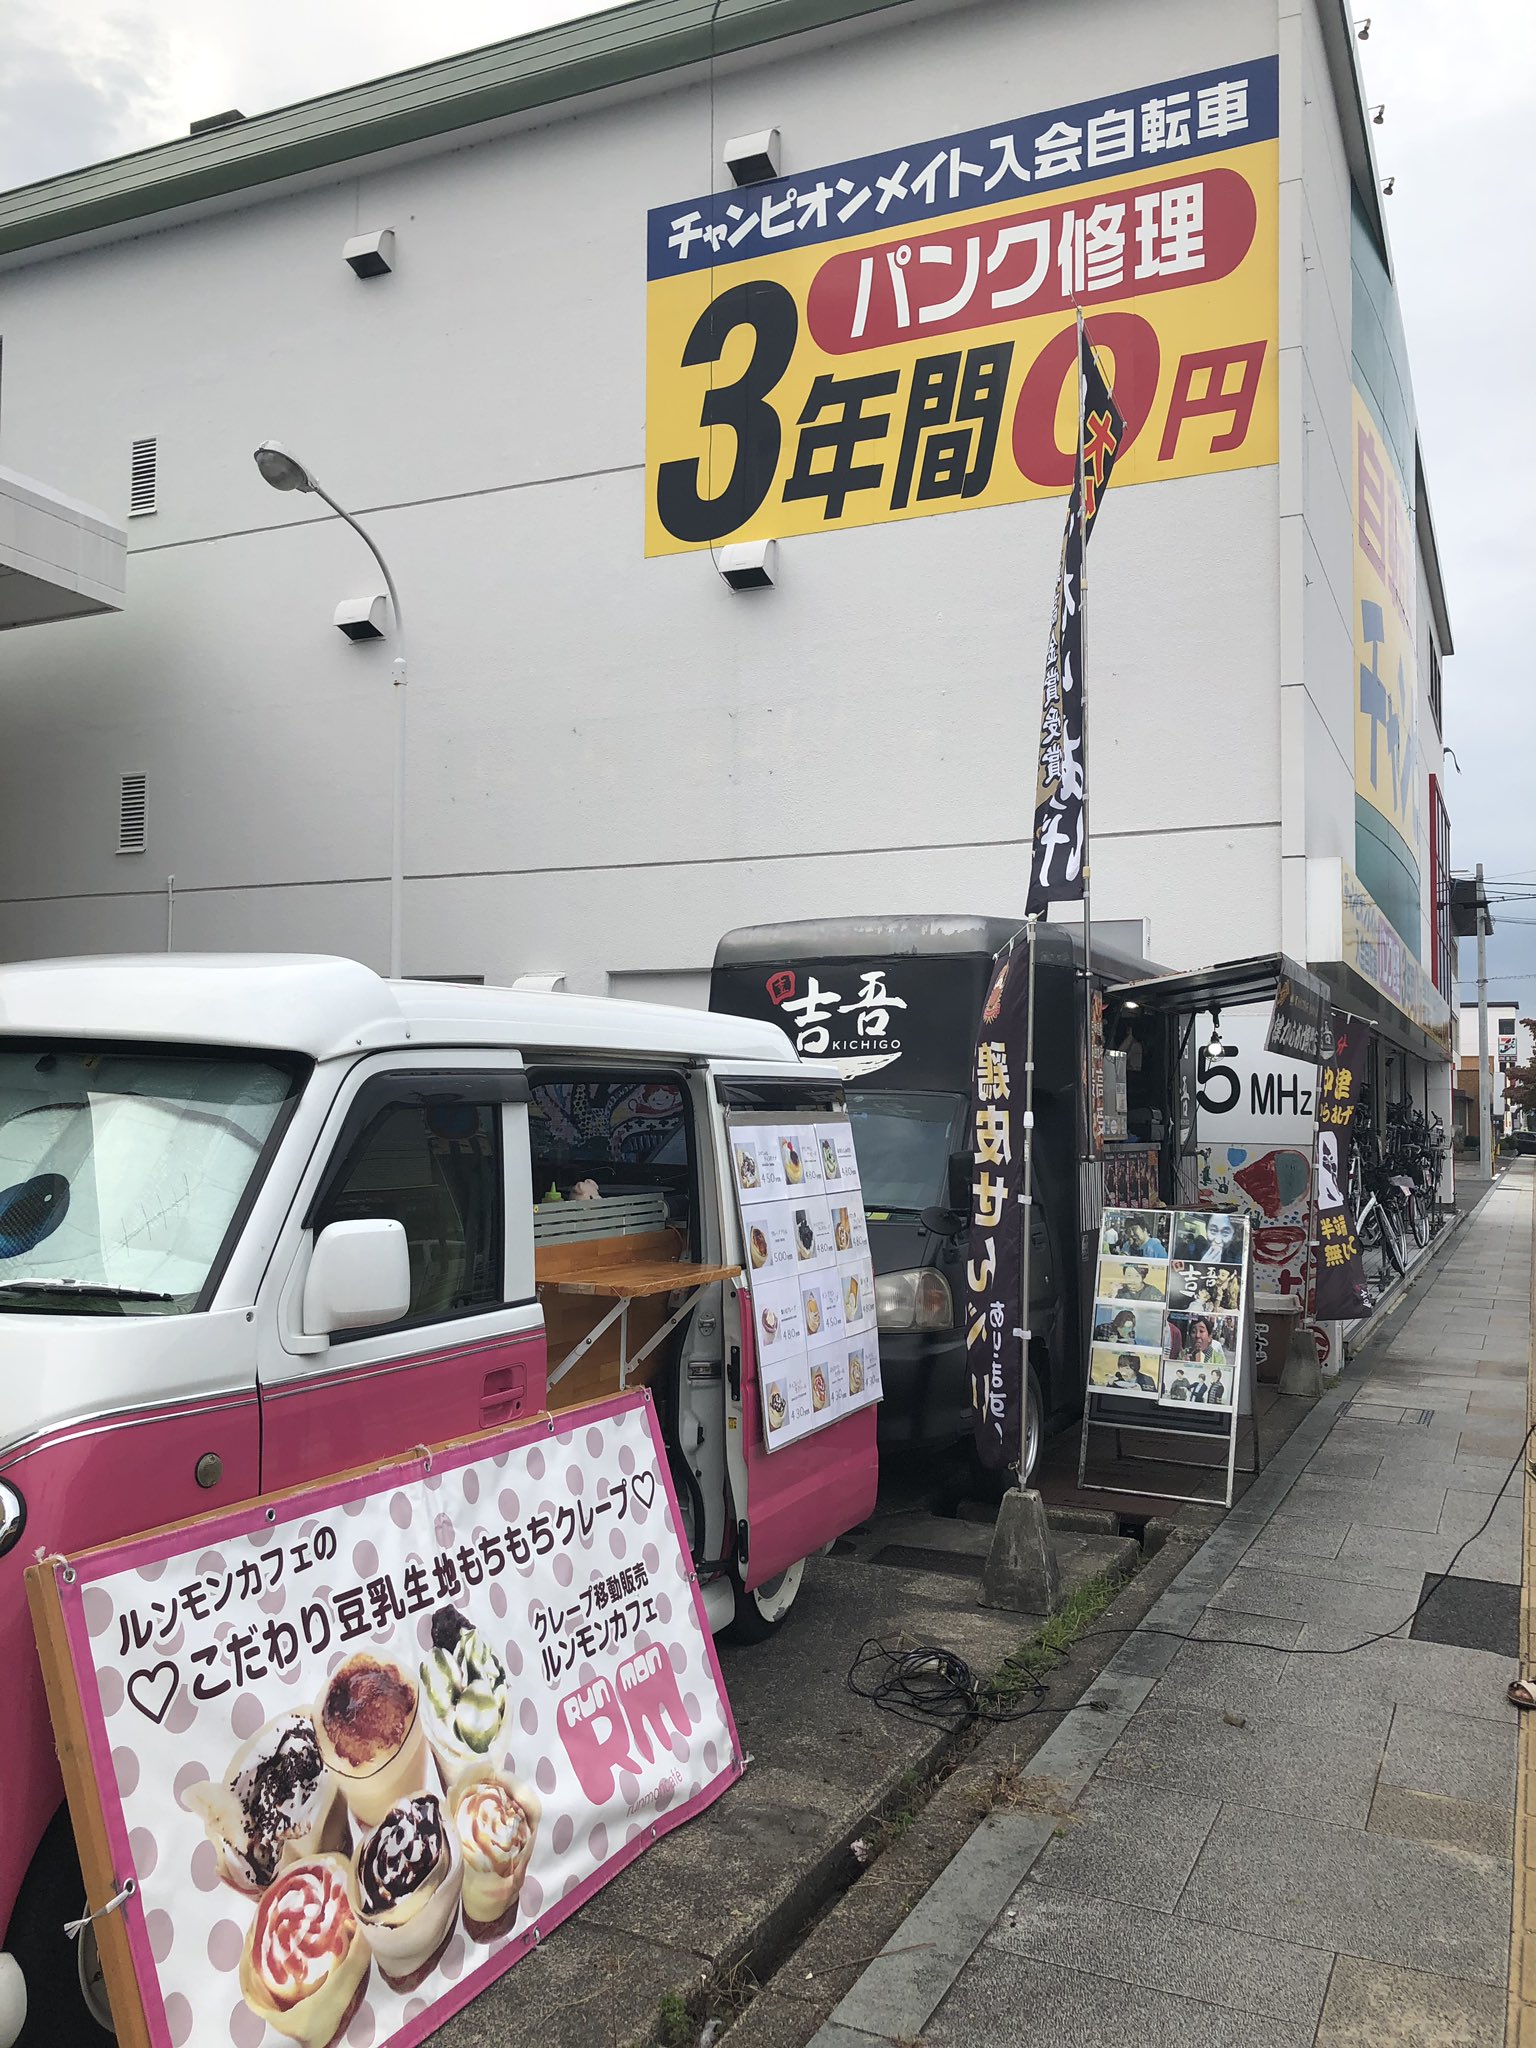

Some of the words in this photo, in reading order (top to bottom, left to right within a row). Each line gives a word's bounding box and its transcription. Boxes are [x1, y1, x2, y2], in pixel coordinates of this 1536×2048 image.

[668, 78, 1250, 260] チャンピオンメイト入会自転車
[850, 183, 1206, 338] パンク修理
[657, 279, 1268, 542] 3年間0円
[781, 971, 908, 1053] 吉吾
[832, 1040, 901, 1050] KICHIGO
[1251, 1073, 1313, 1116] MHz
[1320, 1214, 1348, 1240] 半端
[1178, 1264, 1218, 1297] 吉吾
[120, 1526, 337, 1656] ルンモンカフェの
[190, 1478, 628, 1700] こだわり豆乳生地もちもちクレープ
[534, 1561, 649, 1644] クレープ移動販売
[541, 1597, 658, 1682] ルンモンカフェ
